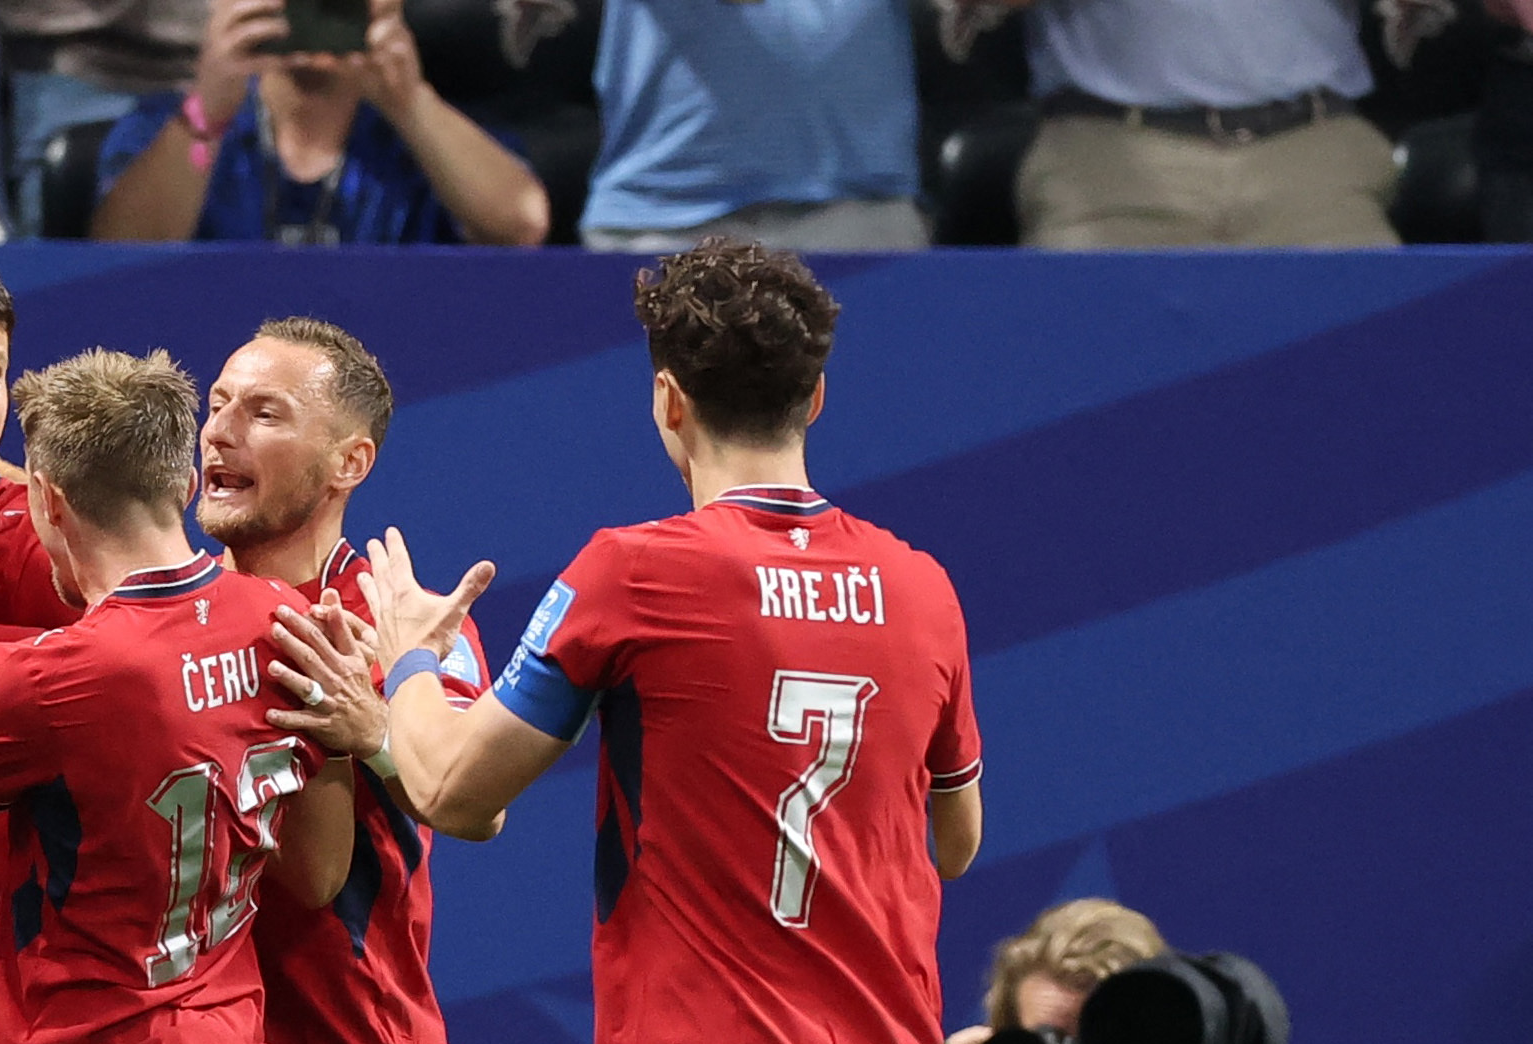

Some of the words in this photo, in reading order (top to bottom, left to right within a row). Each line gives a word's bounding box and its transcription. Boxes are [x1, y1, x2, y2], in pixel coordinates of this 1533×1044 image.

[756, 566, 885, 625] KREJČÍ
[146, 735, 306, 988] 12
[768, 669, 879, 928] 7
